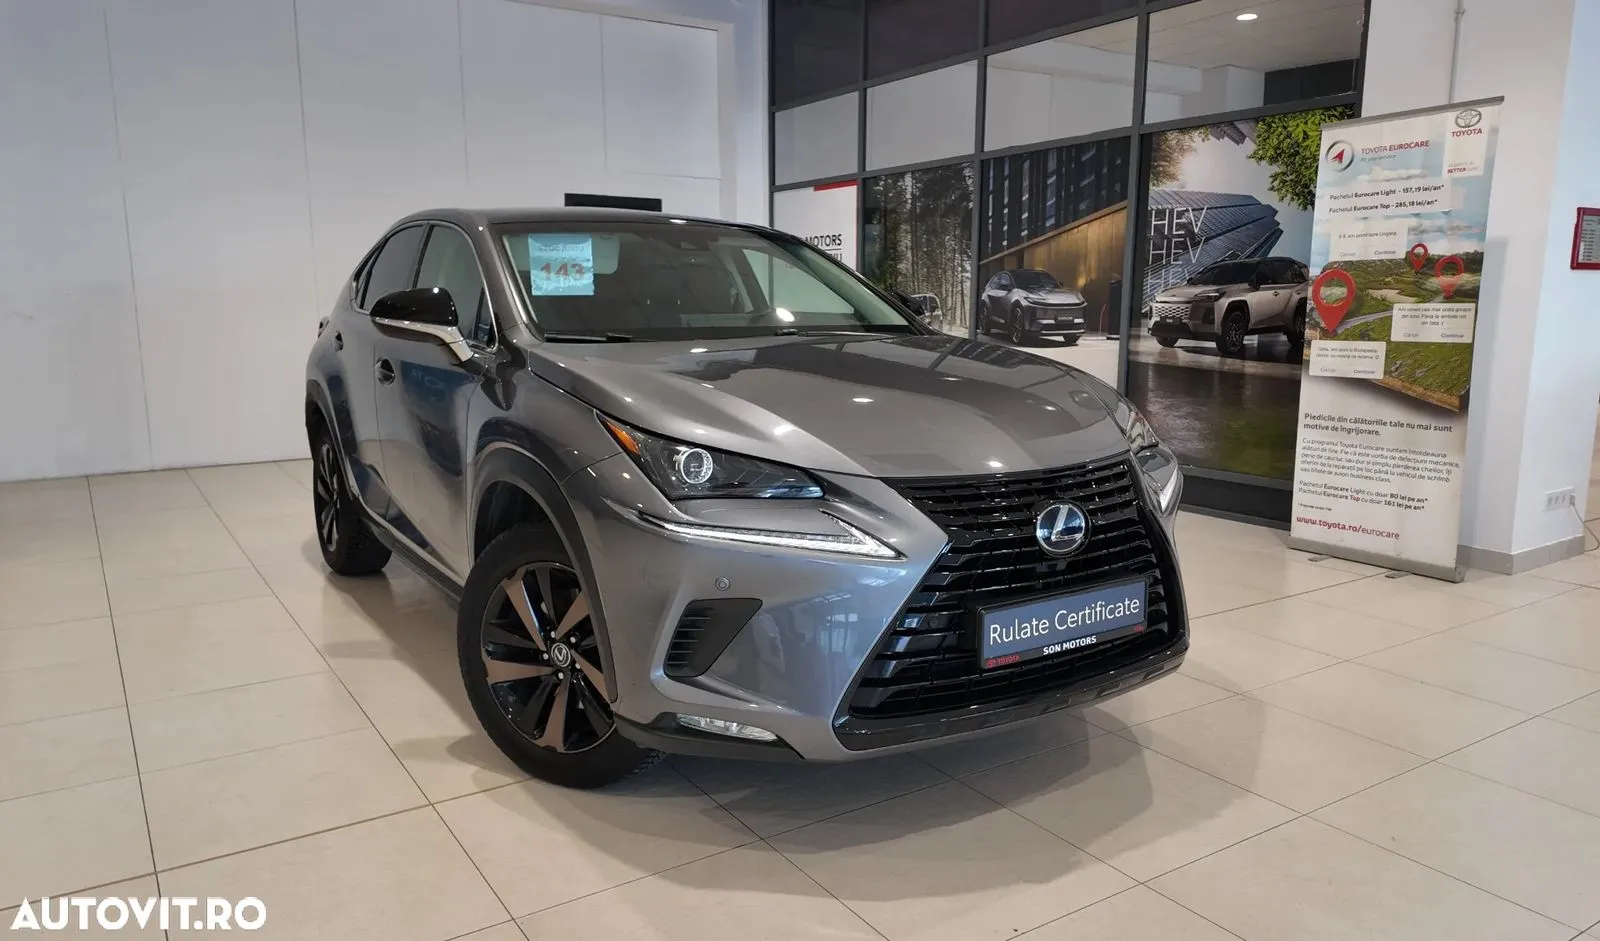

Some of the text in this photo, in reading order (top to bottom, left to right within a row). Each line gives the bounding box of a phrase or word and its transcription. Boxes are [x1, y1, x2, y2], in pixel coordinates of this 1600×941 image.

[1451, 128, 1482, 137] TOYOTA
[1361, 140, 1430, 155] TOYOTA EUROCARE
[1380, 189, 1396, 197] Light
[1402, 186, 1421, 194] 157,19
[1151, 206, 1208, 236] HEV
[1149, 237, 1205, 265] HEV
[1304, 413, 1336, 422] Piedicile
[1349, 417, 1388, 426] călătoriile
[1304, 423, 1329, 431] motive
[1340, 441, 1358, 449] Toyota
[1350, 473, 1374, 481] business
[1299, 480, 1323, 489] Pachetul
[1324, 484, 1349, 492] Eurocare
[1350, 487, 1366, 495] Light
[1299, 487, 1322, 496] Pachetul
[1323, 491, 1348, 500] Eurocare
[1296, 516, 1400, 540] www.toyota.ro/eurocare
[990, 597, 1140, 646] Rulate Certificate
[1043, 635, 1097, 656] SON MOTORS
